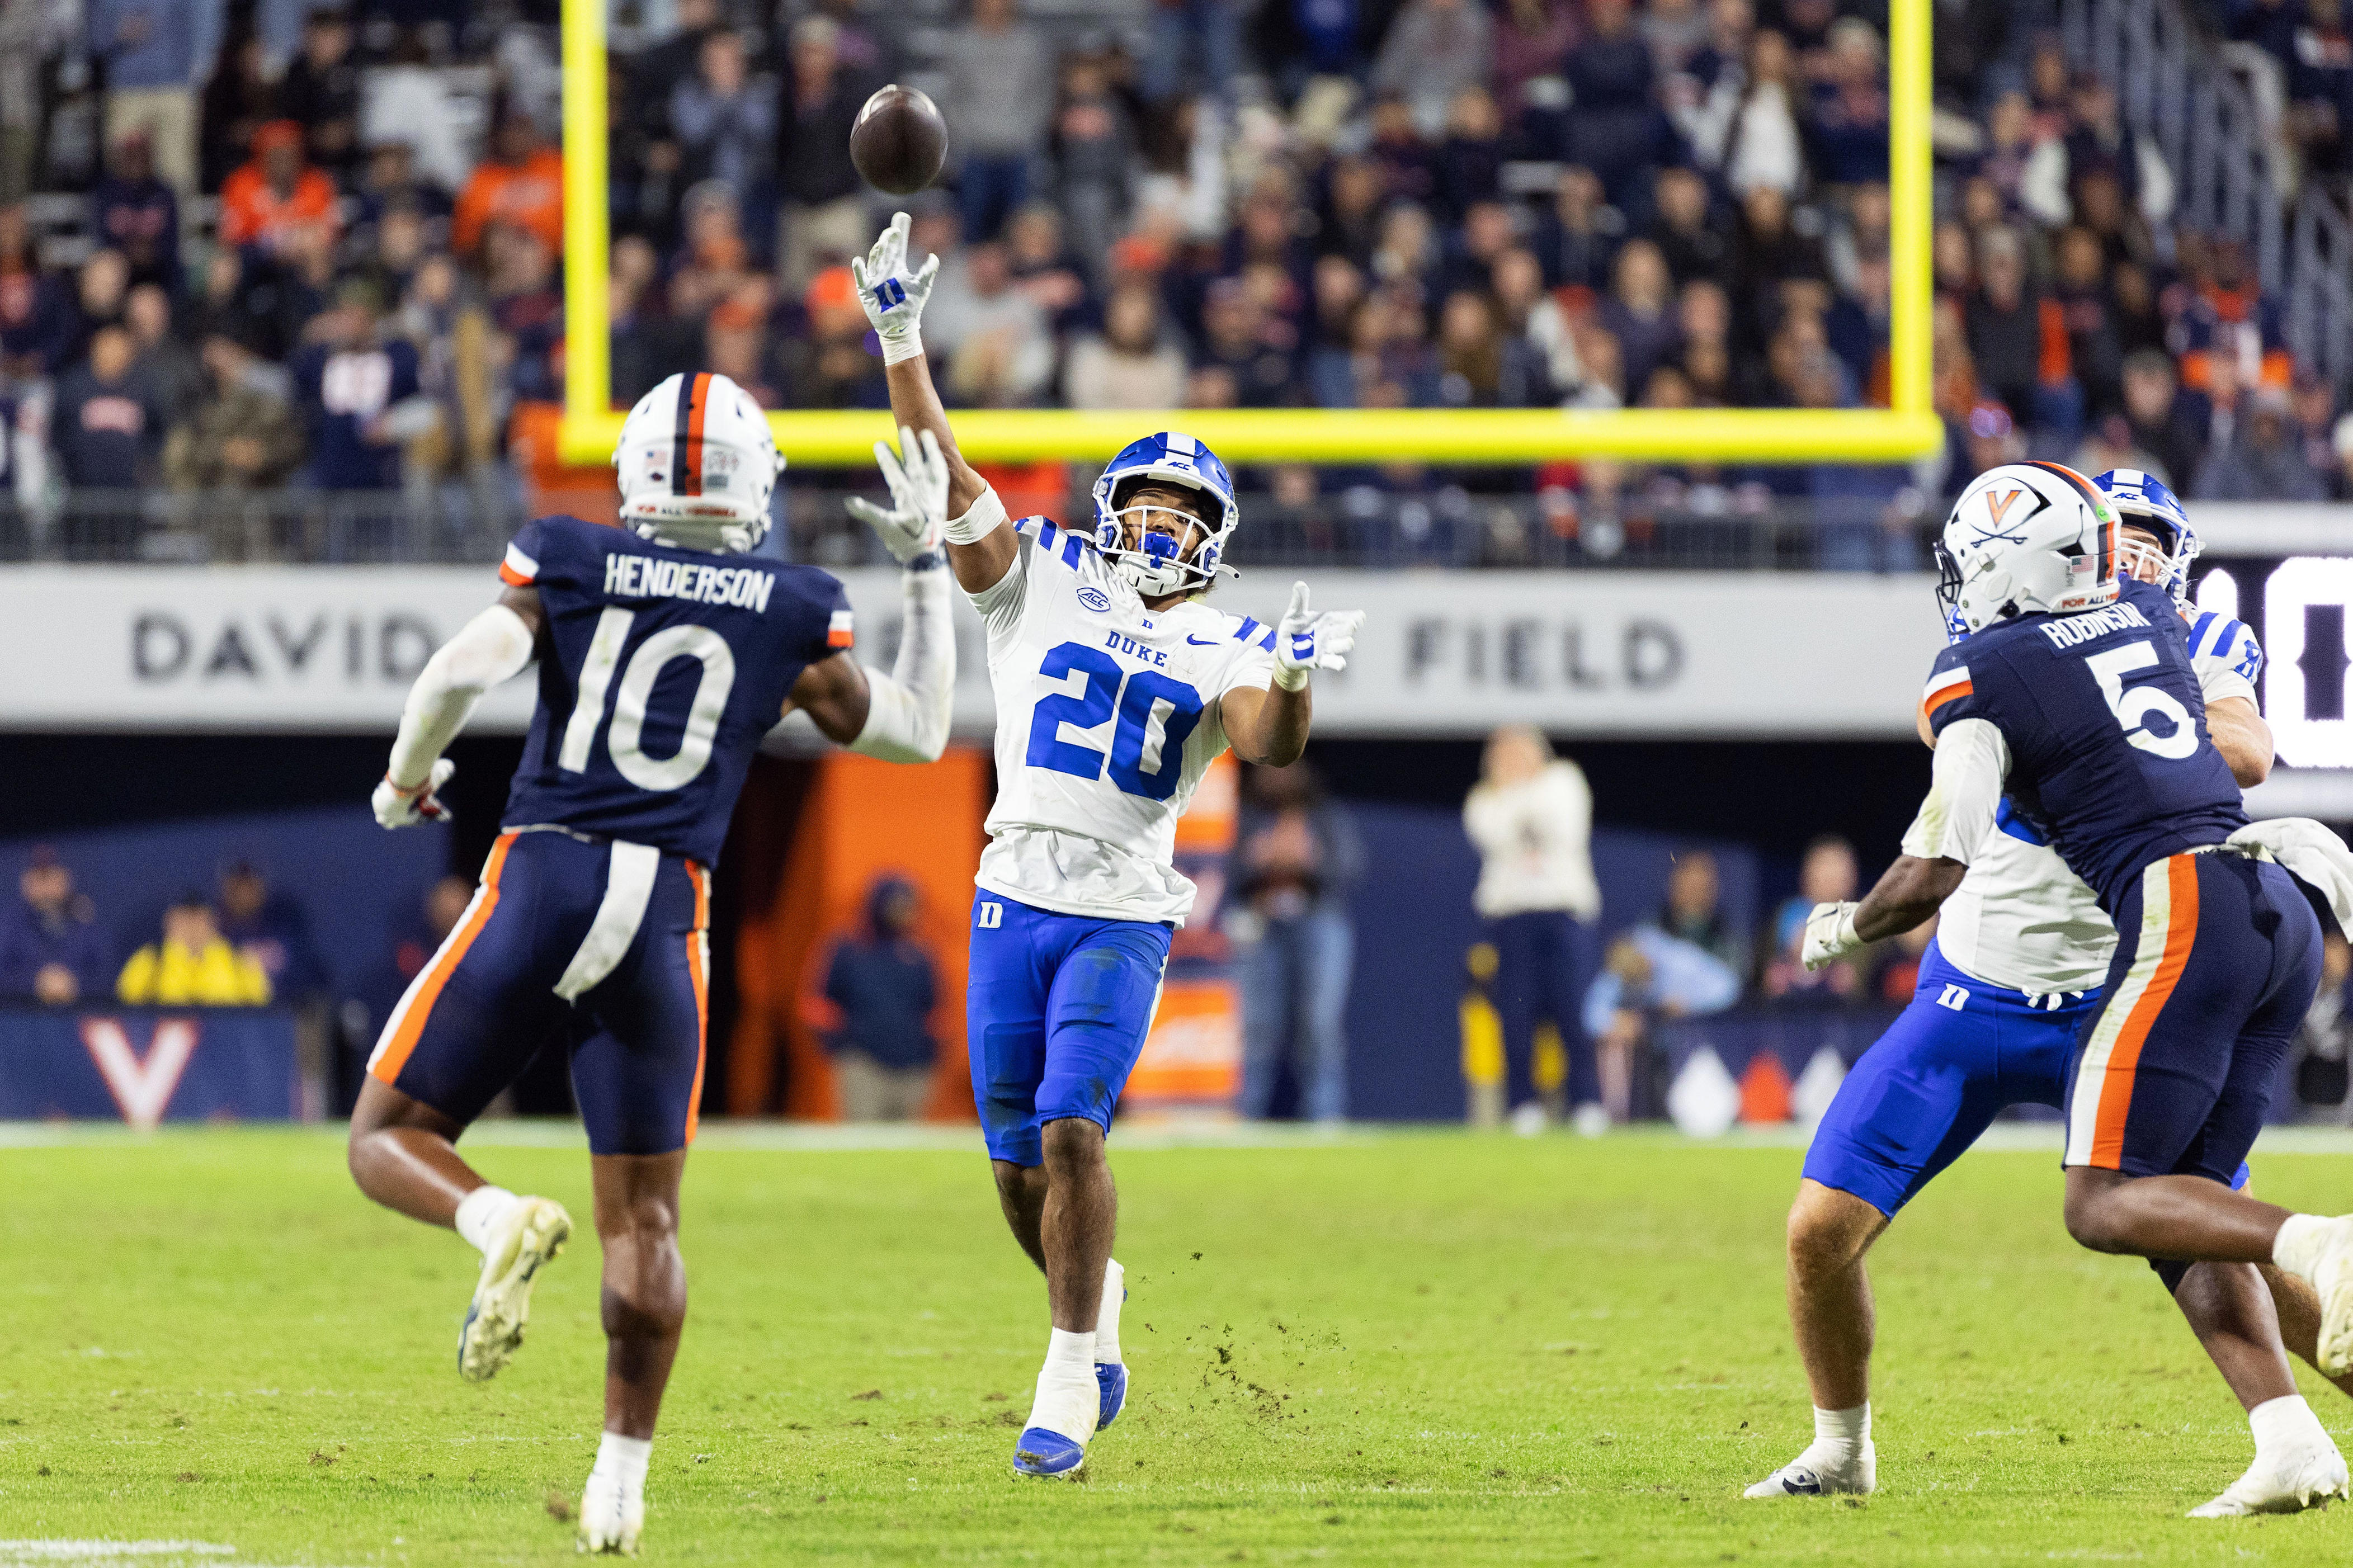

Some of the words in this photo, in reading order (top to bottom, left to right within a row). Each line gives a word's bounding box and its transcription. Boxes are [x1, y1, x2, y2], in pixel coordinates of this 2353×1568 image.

[1167, 461, 1191, 470] ACC
[1986, 490, 2022, 529] V
[604, 554, 775, 613] HENDERSON
[1082, 593, 1109, 607] ACC
[2062, 597, 2086, 609] FOR
[2088, 594, 2104, 606] ALL
[2038, 601, 2152, 649] ROBINSON
[132, 608, 440, 684] DAVID
[1404, 613, 1687, 693] FIELD
[1105, 630, 1167, 667] DUKE
[559, 605, 735, 791] 10
[2085, 640, 2199, 759] 5
[1025, 641, 1204, 802] 20
[977, 901, 1004, 929] D
[1936, 983, 1970, 1011] D
[79, 1018, 200, 1128] V
